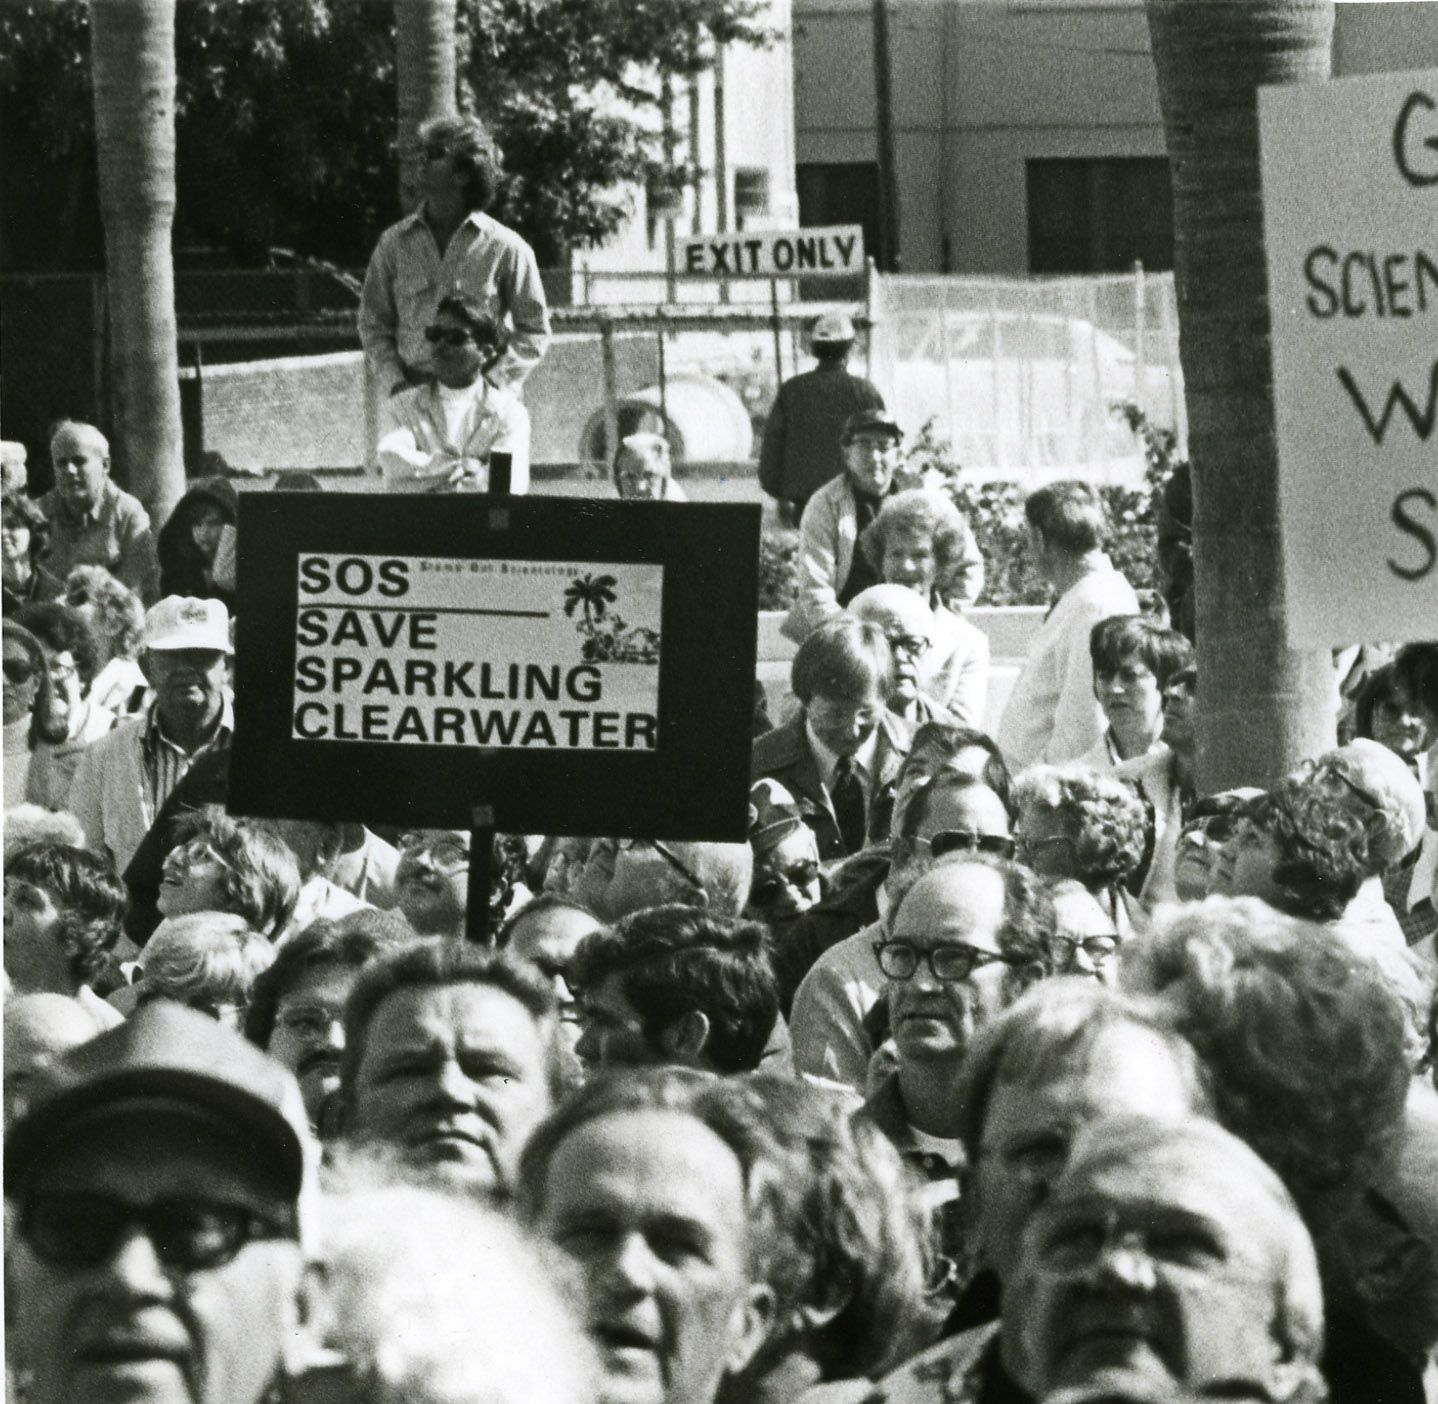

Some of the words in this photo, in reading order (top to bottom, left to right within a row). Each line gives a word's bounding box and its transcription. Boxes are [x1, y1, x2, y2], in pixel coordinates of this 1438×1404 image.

[686, 240, 761, 274] EXIT
[772, 236, 855, 271] ONLY
[299, 557, 410, 597] SOS
[297, 609, 438, 650] SAVE
[295, 655, 602, 702] SPARKLING
[294, 702, 657, 749] CLEARWATER
